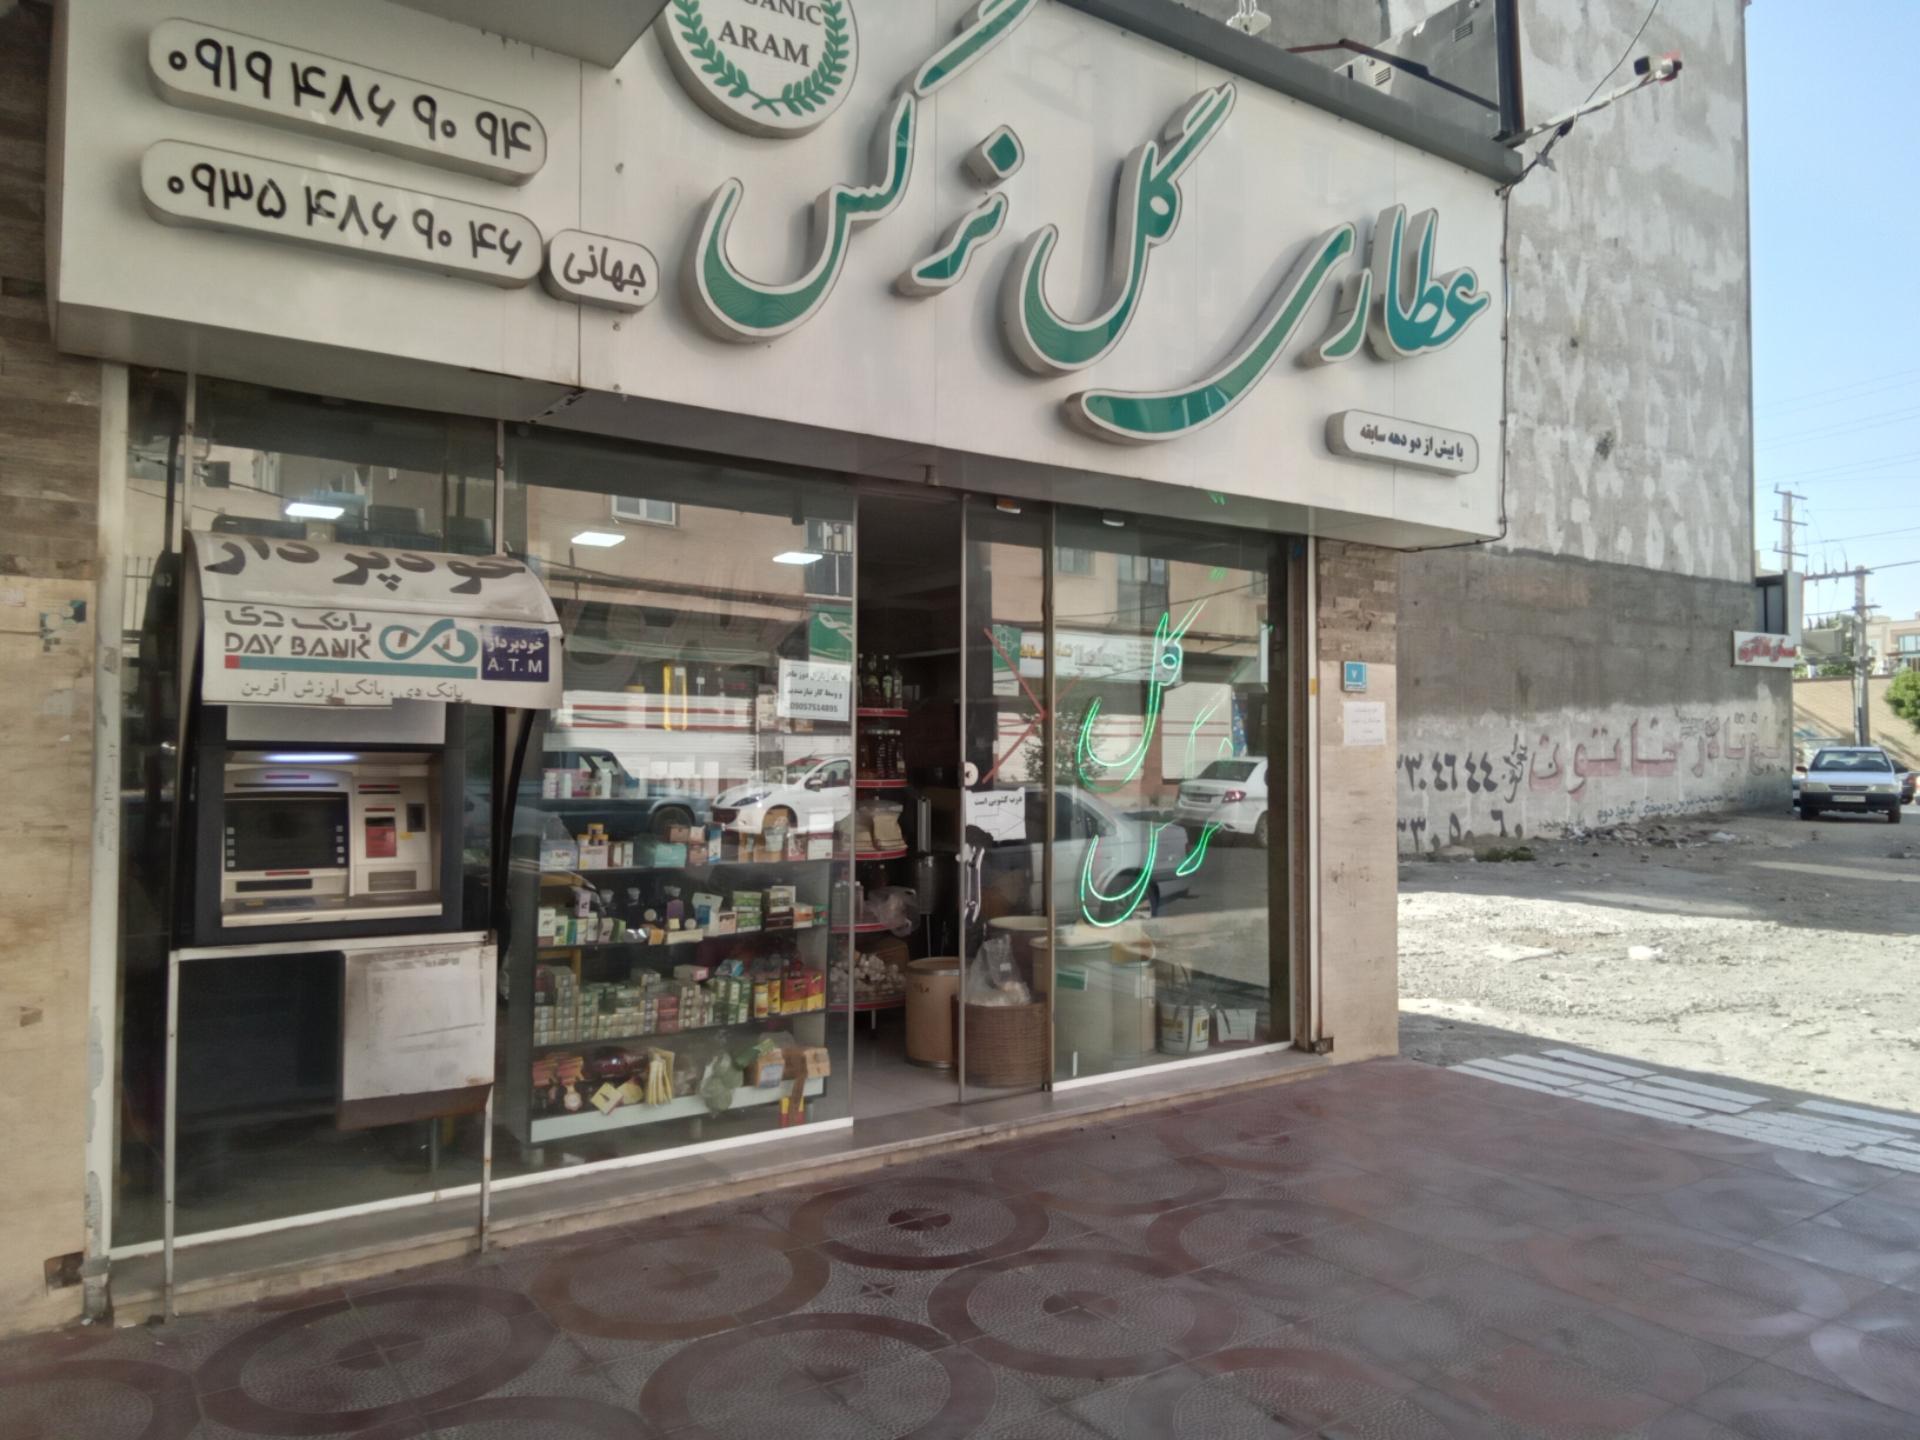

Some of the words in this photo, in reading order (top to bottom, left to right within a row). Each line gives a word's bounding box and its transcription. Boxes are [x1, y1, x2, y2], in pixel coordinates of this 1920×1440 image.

[743, 0, 822, 26] ANIC
[718, 20, 811, 67] ARAM
[169, 39, 272, 99] ۰۹۱۹
[292, 62, 396, 127] ۴۸۶
[476, 111, 532, 159] ۹۴
[697, 0, 1037, 338] نرگس
[168, 163, 287, 219] ۰۹۳۵
[305, 186, 398, 240] ۴۸۶
[470, 221, 523, 264] ۴۶
[1014, 81, 1237, 372] گل
[563, 245, 647, 296] جهانی
[1078, 203, 1491, 443] عطاری
[1360, 424, 1387, 445] سابقه
[1388, 431, 1407, 446] دهه
[1409, 437, 1422, 453] دو
[1424, 436, 1434, 456] از
[1434, 439, 1455, 460] بیش
[224, 605, 285, 629] دی
[291, 611, 373, 640] بانک
[224, 632, 283, 655] DAY
[291, 635, 373, 659] BANK
[486, 634, 545, 655] خودپرداز
[241, 673, 288, 697] آفرین
[293, 679, 340, 699] ارزش
[344, 679, 386, 699] بانک
[426, 682, 465, 701] بانک
